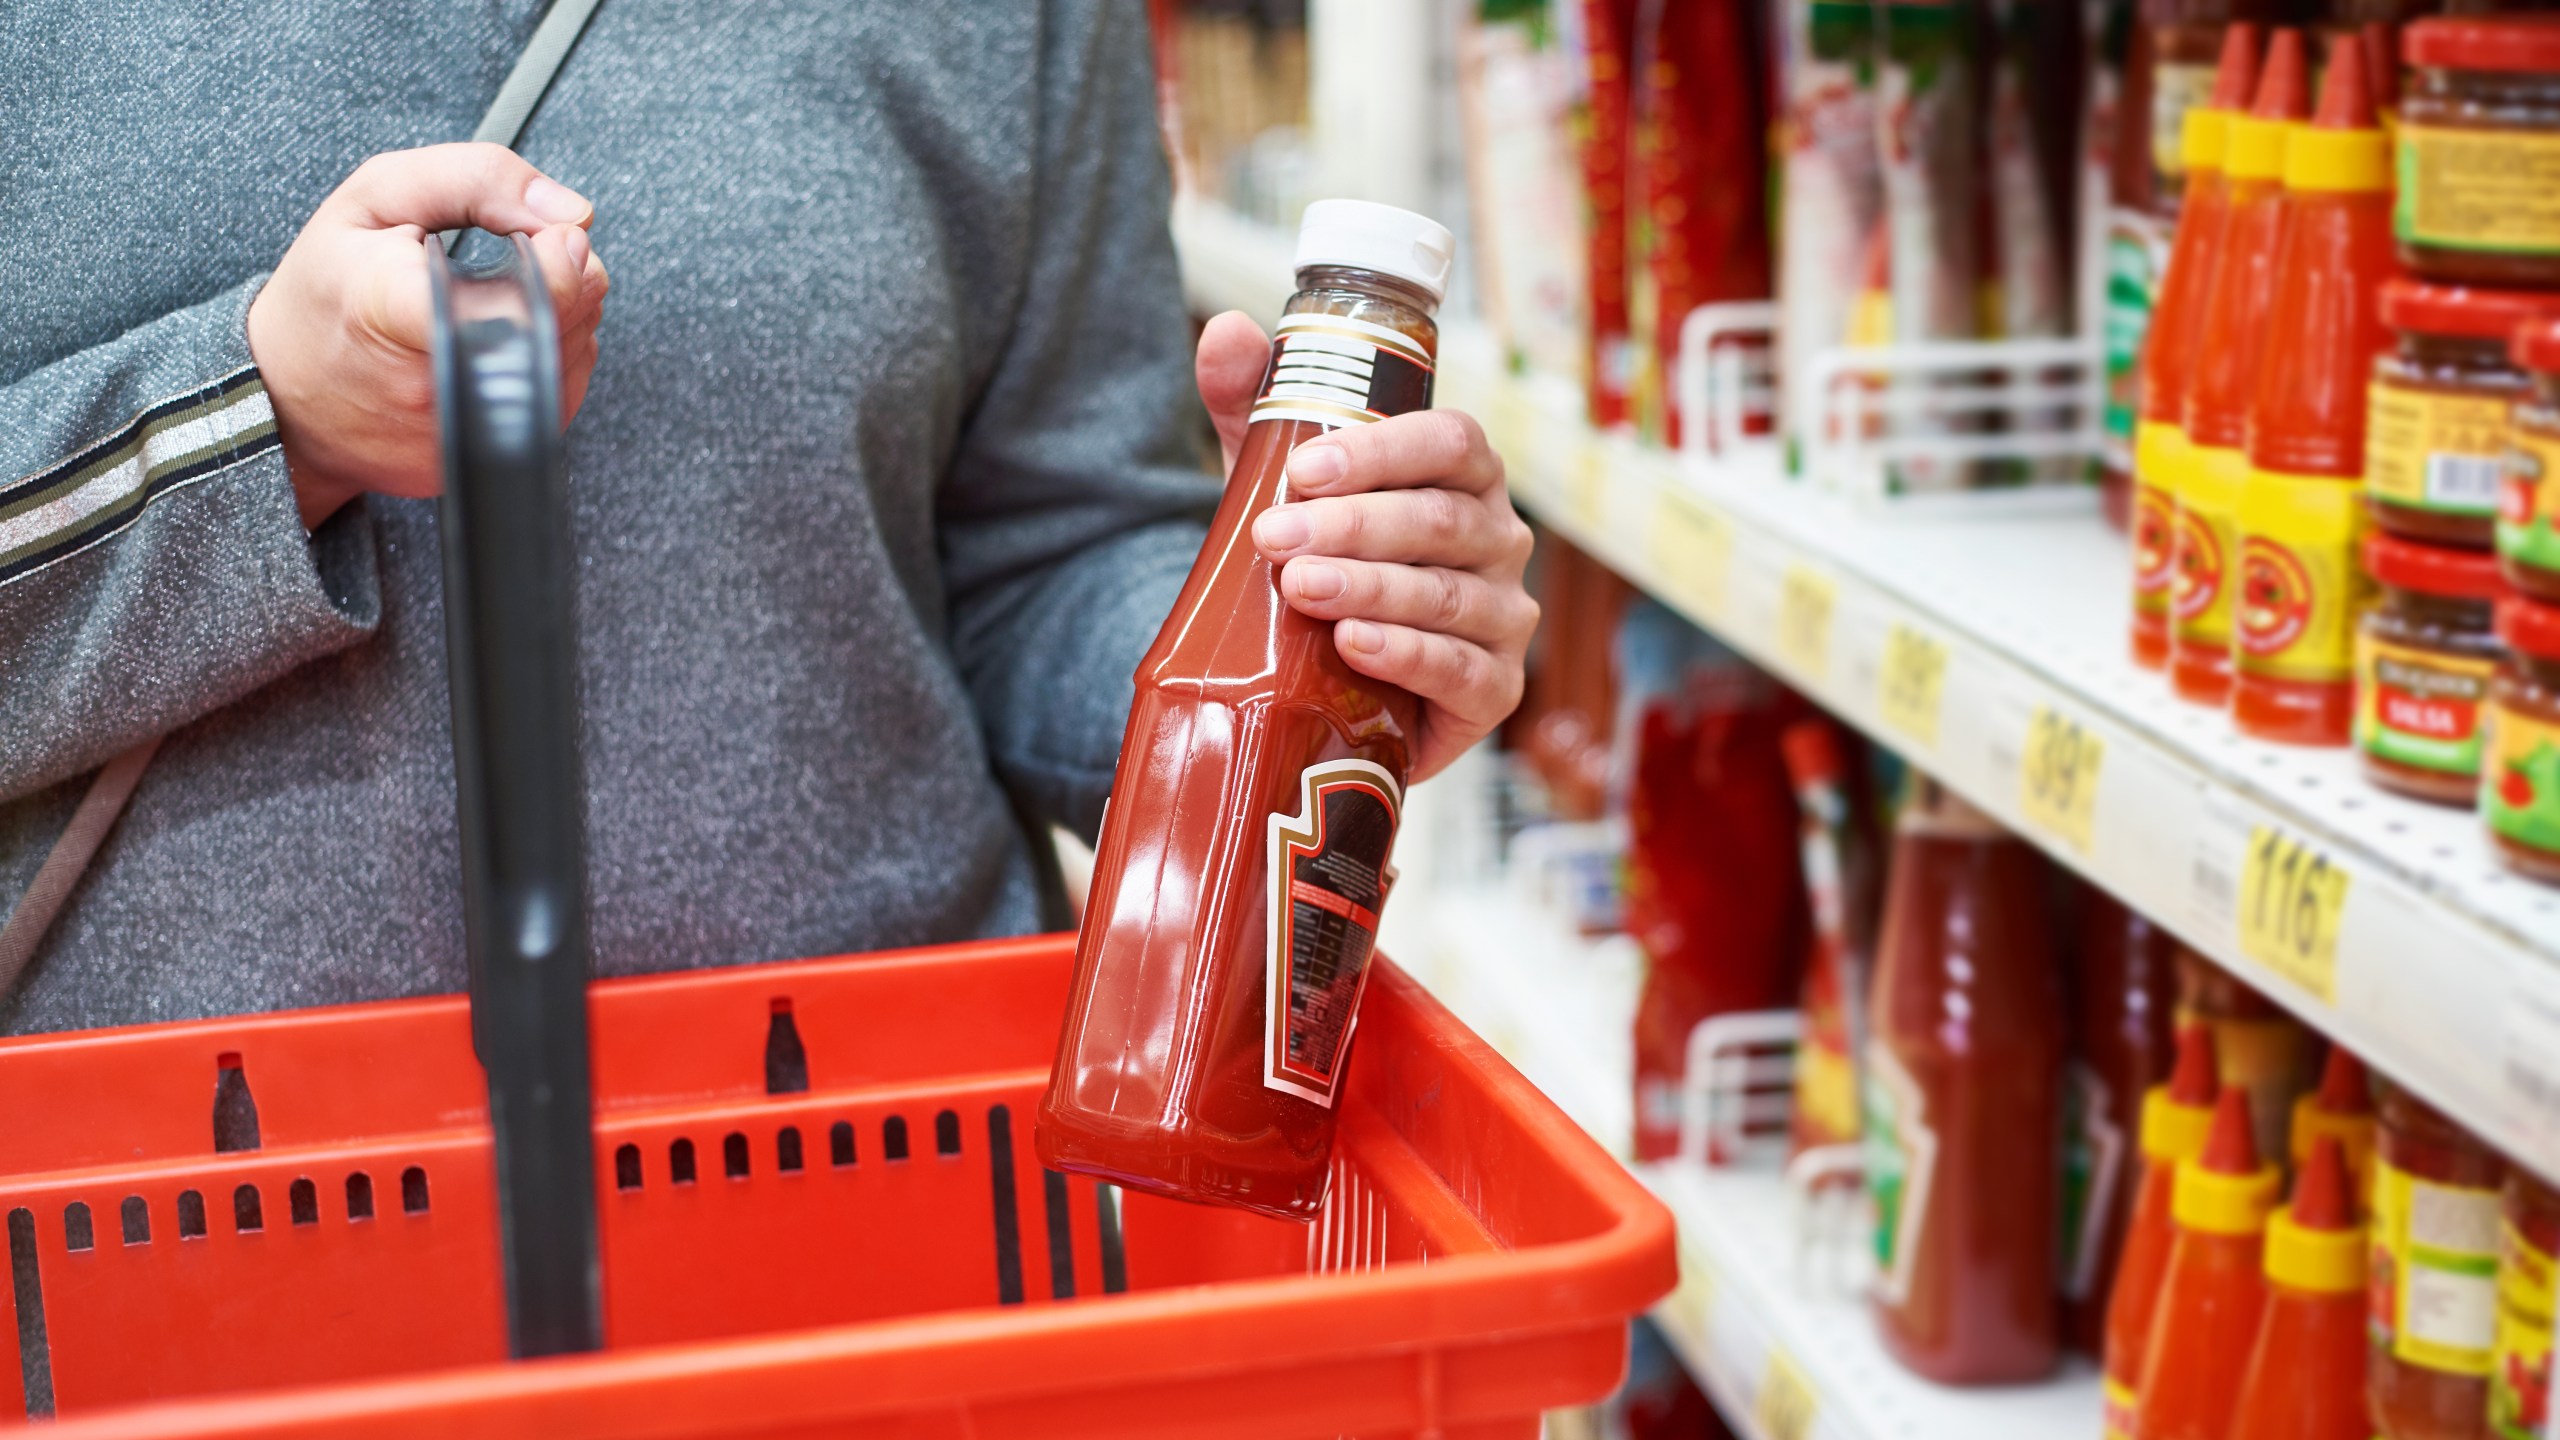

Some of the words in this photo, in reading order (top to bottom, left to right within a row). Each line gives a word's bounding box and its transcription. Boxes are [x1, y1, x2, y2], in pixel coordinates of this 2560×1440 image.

[2031, 709, 2082, 812] 39
[2387, 698, 2456, 735] SALSA
[2253, 829, 2327, 957] 116
